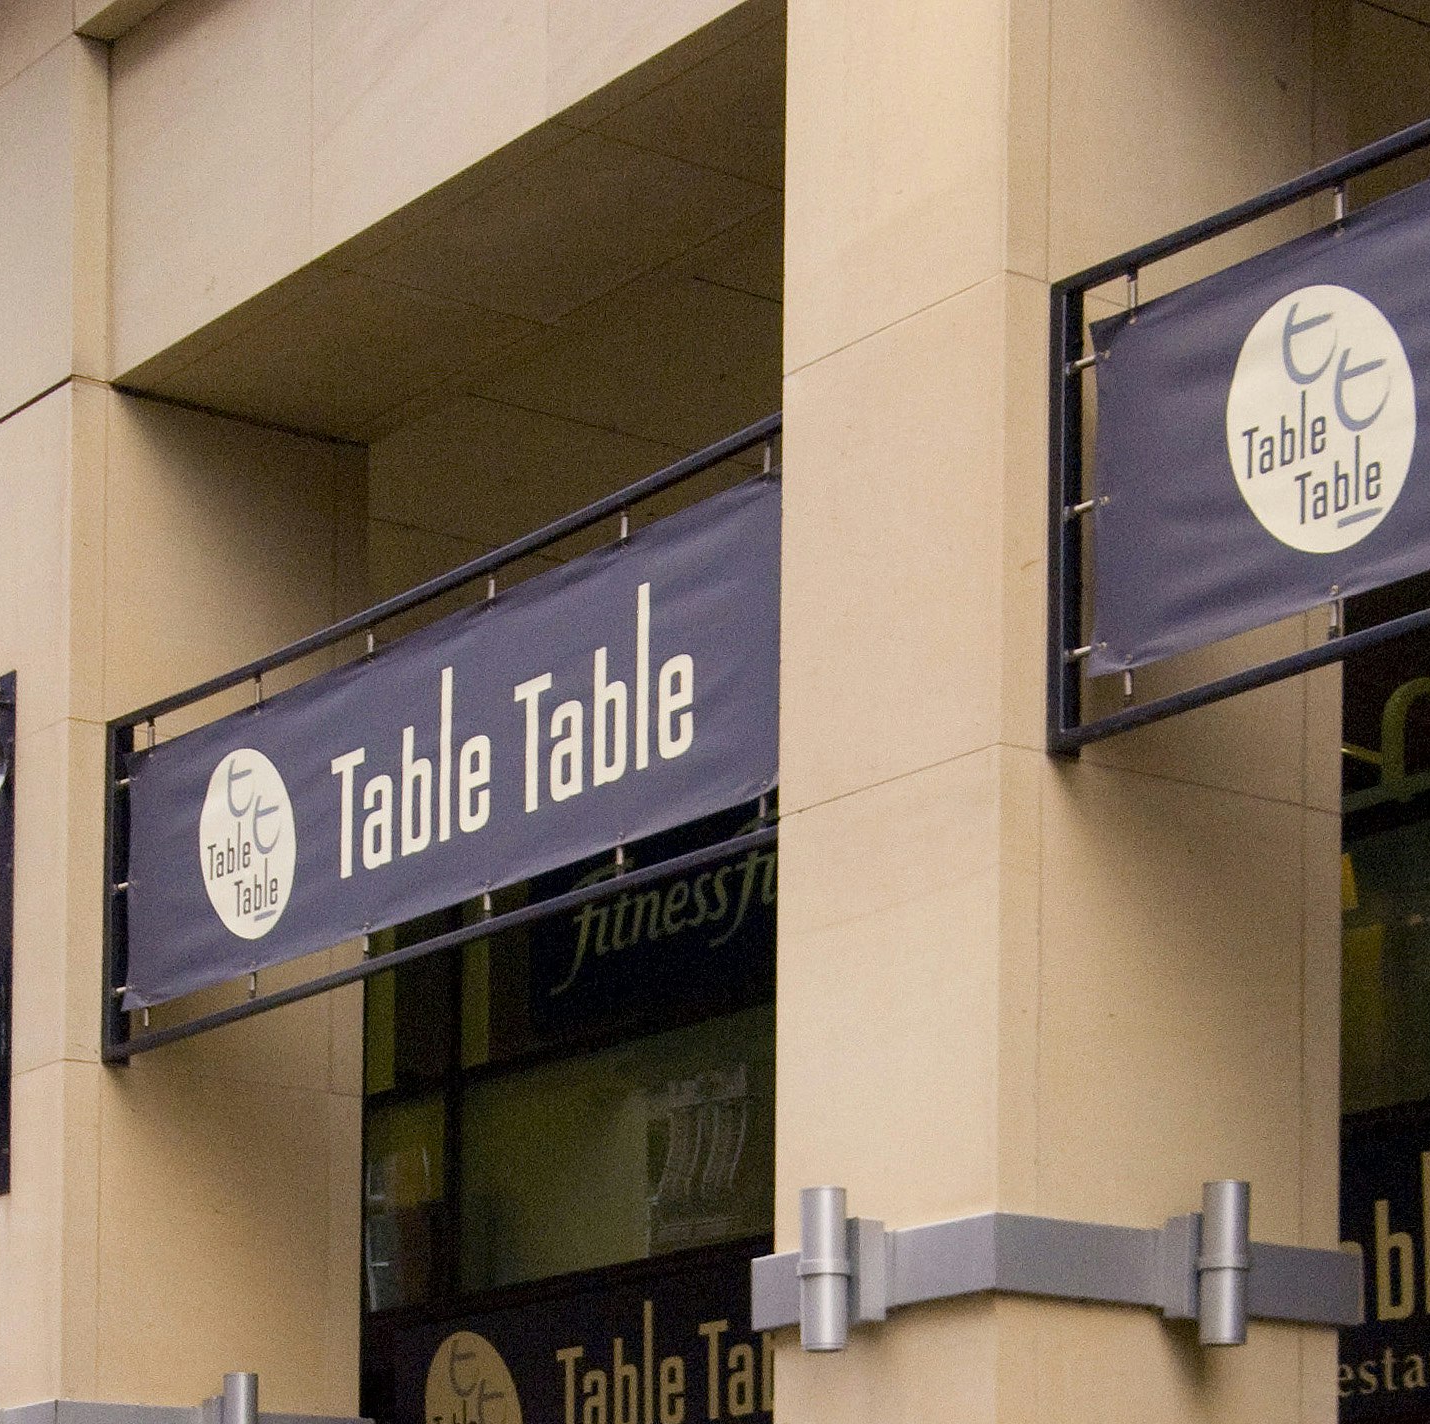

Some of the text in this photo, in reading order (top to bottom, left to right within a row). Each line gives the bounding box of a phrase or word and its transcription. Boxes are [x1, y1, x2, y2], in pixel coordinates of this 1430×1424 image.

[1242, 390, 1327, 479] Table
[1294, 434, 1382, 525] Table
[331, 582, 694, 879] Table Table
[207, 821, 251, 880] Table
[234, 857, 279, 917] Table
